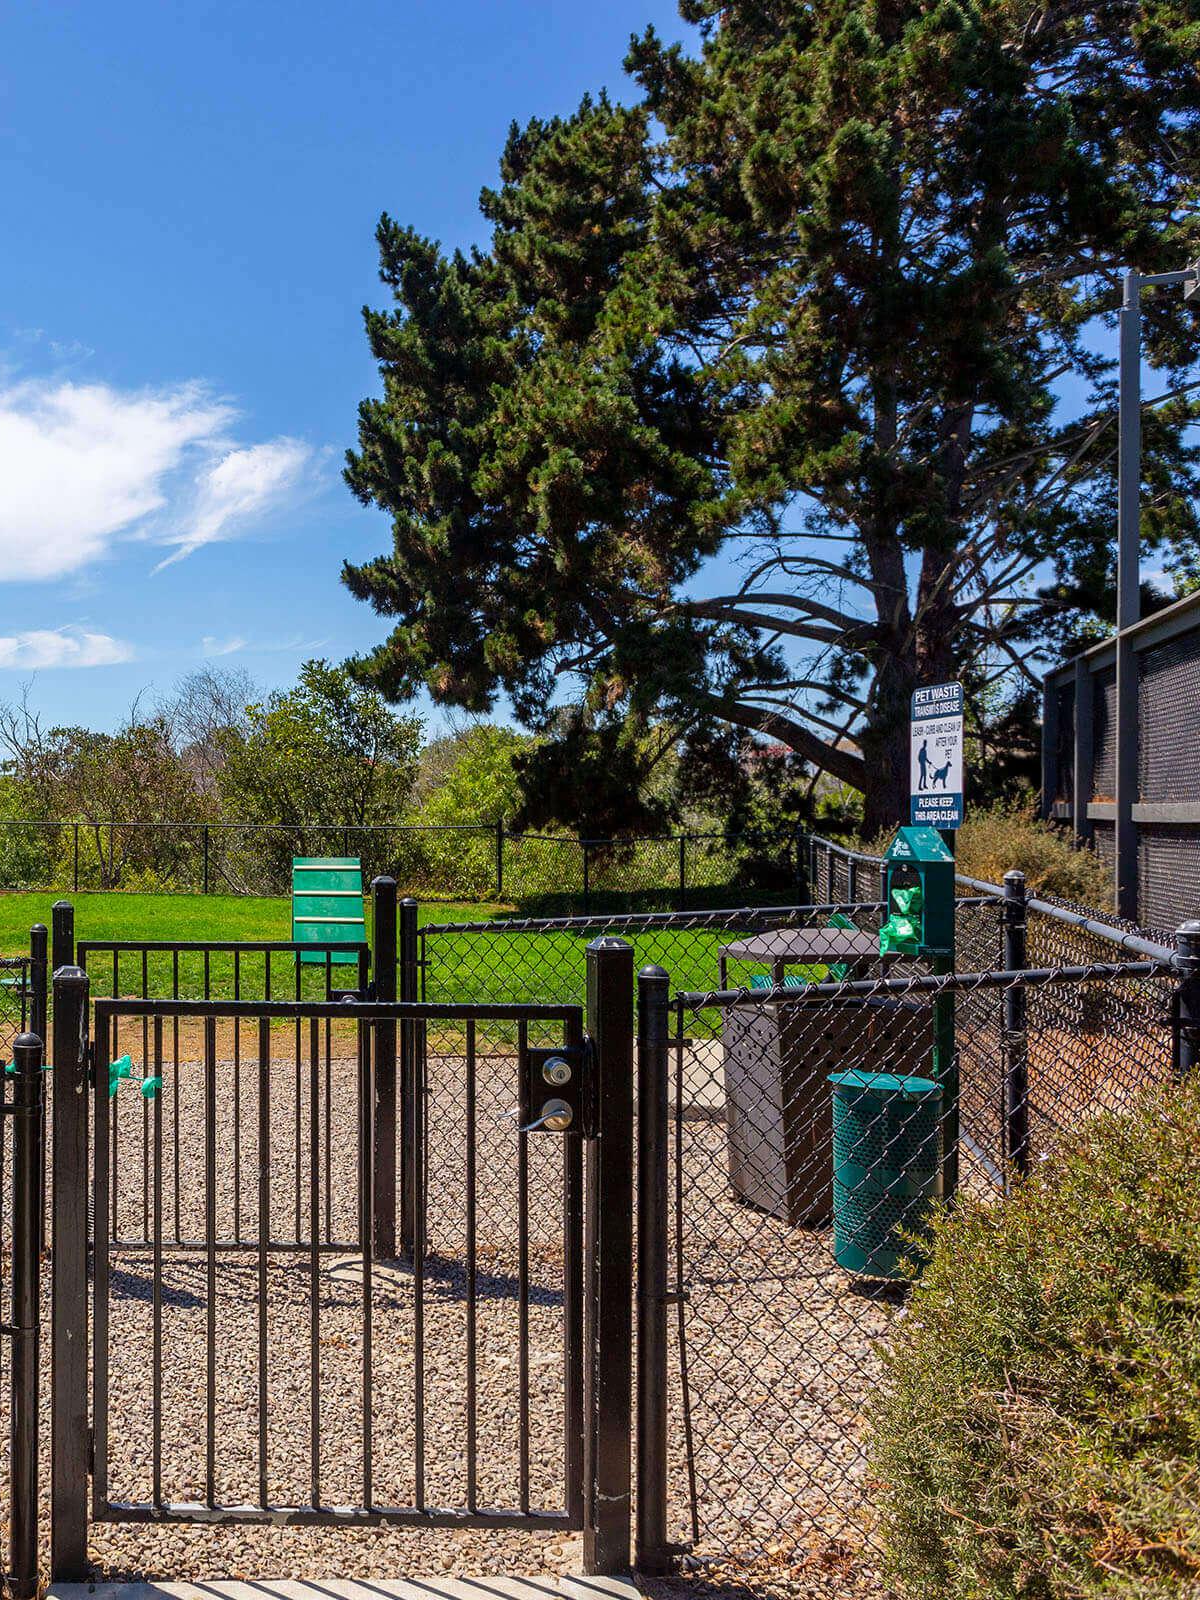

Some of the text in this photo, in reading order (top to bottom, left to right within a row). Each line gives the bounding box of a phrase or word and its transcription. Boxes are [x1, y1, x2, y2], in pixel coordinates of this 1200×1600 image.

[915, 685, 959, 702] PET WASTE
[939, 701, 960, 714] DISEASE
[919, 797, 953, 807] PLEASE KEEP
[927, 811, 940, 820] AREA
[941, 810, 958, 820] CLEAN
